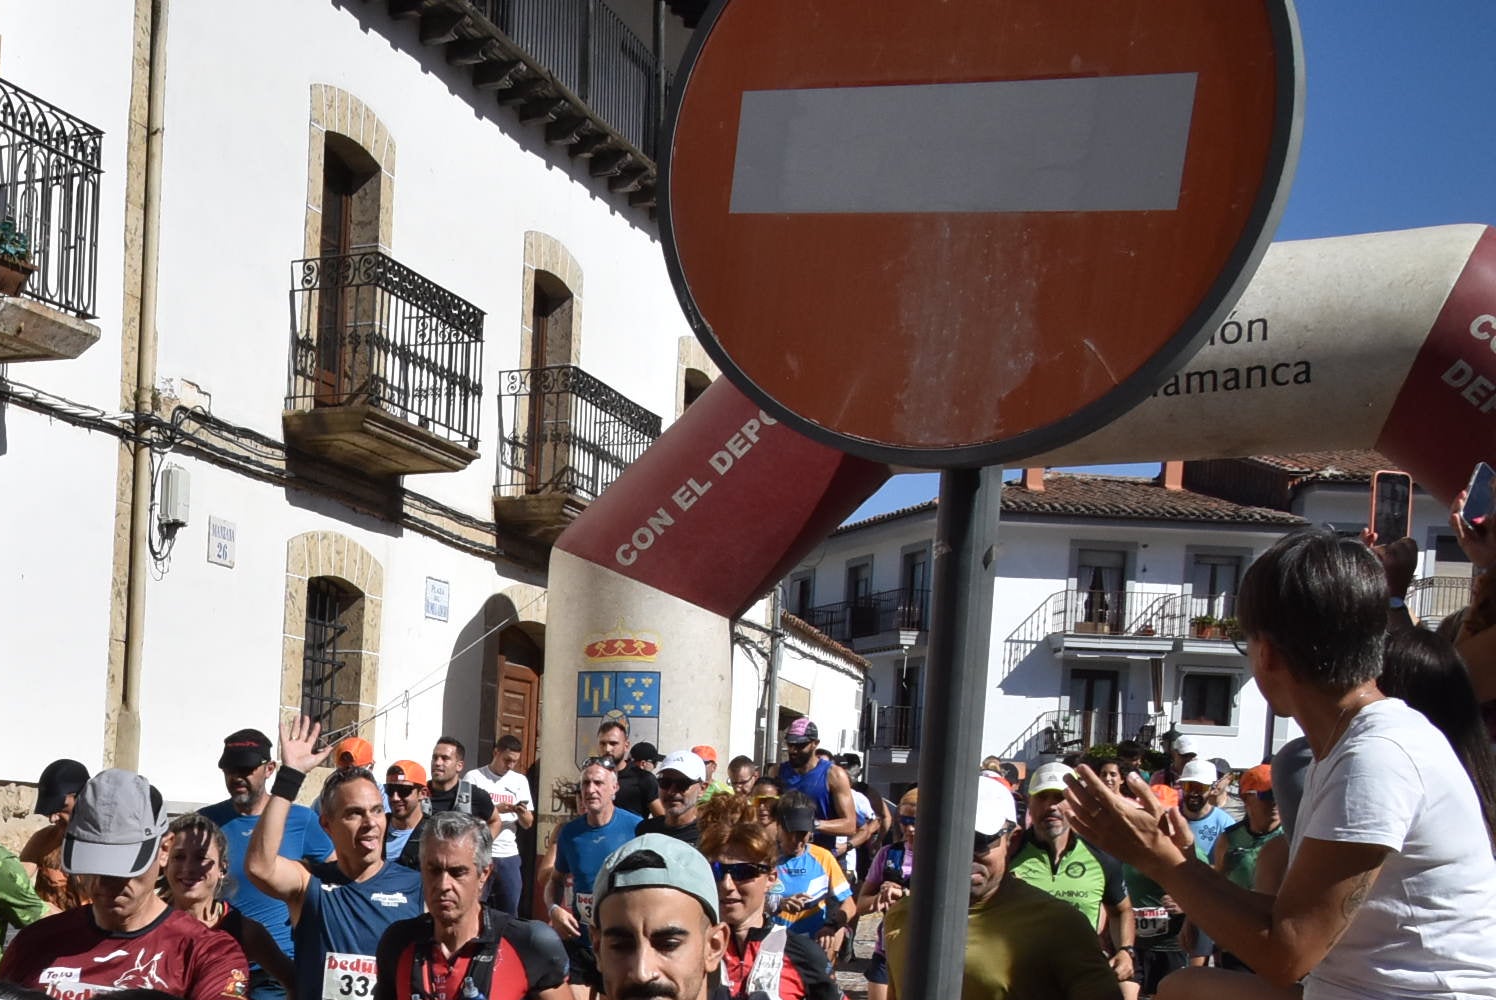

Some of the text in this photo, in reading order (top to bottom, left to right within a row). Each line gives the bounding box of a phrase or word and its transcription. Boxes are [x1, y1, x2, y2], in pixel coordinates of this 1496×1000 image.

[1152, 359, 1313, 397] amanca
[614, 506, 676, 567] CON
[672, 474, 712, 512] EL
[216, 542, 228, 561] 26
[585, 906, 592, 919] 3
[1135, 918, 1157, 930] 01
[339, 975, 375, 997] 33
